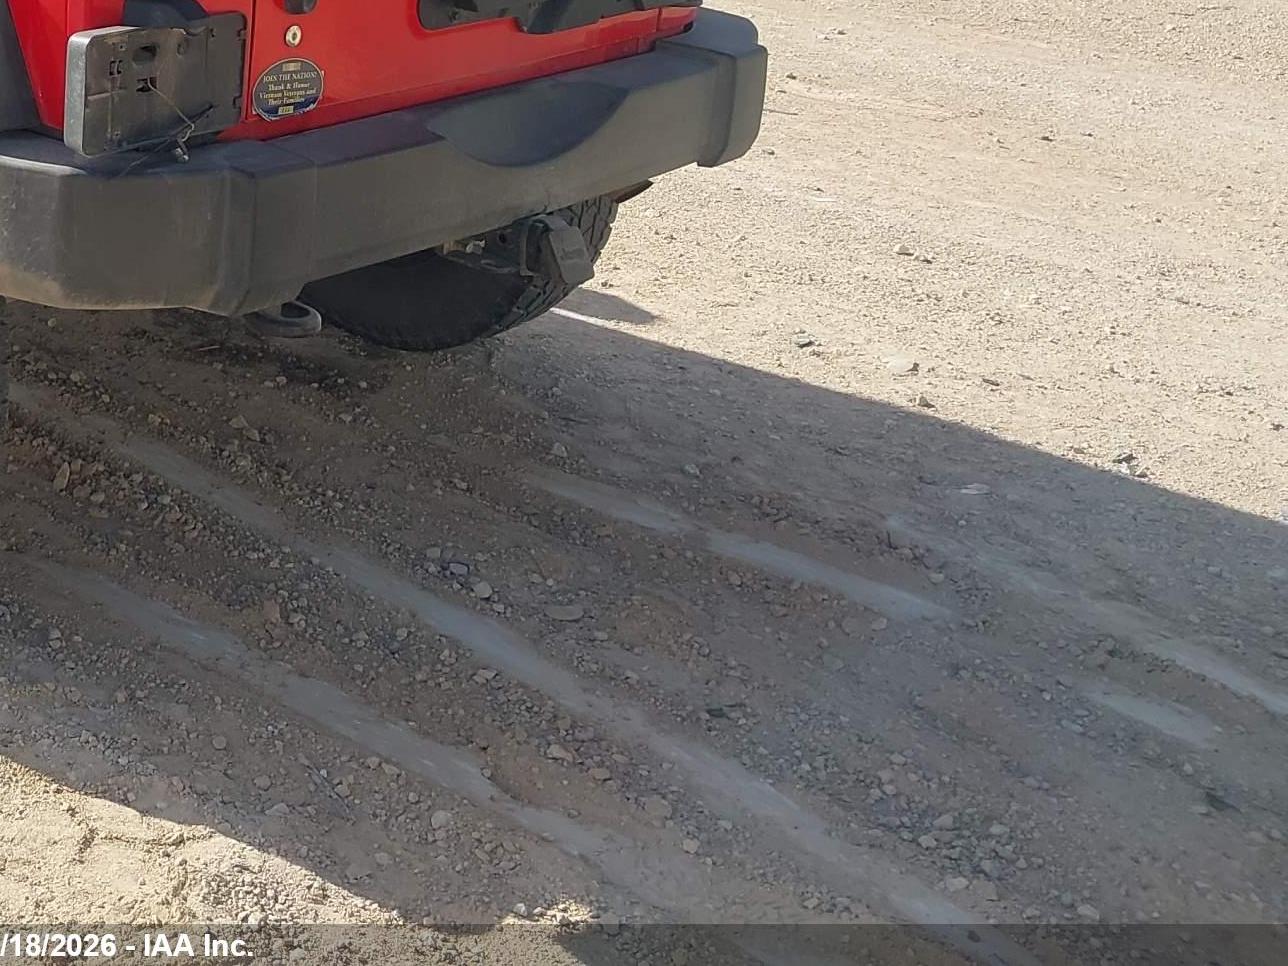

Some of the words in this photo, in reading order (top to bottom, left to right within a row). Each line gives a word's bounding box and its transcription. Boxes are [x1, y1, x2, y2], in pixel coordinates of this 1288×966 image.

[263, 75, 278, 83] JOIN
[279, 73, 291, 81] THE
[293, 81, 311, 89] Honor
[306, 87, 317, 95] and
[268, 98, 283, 106] Their
